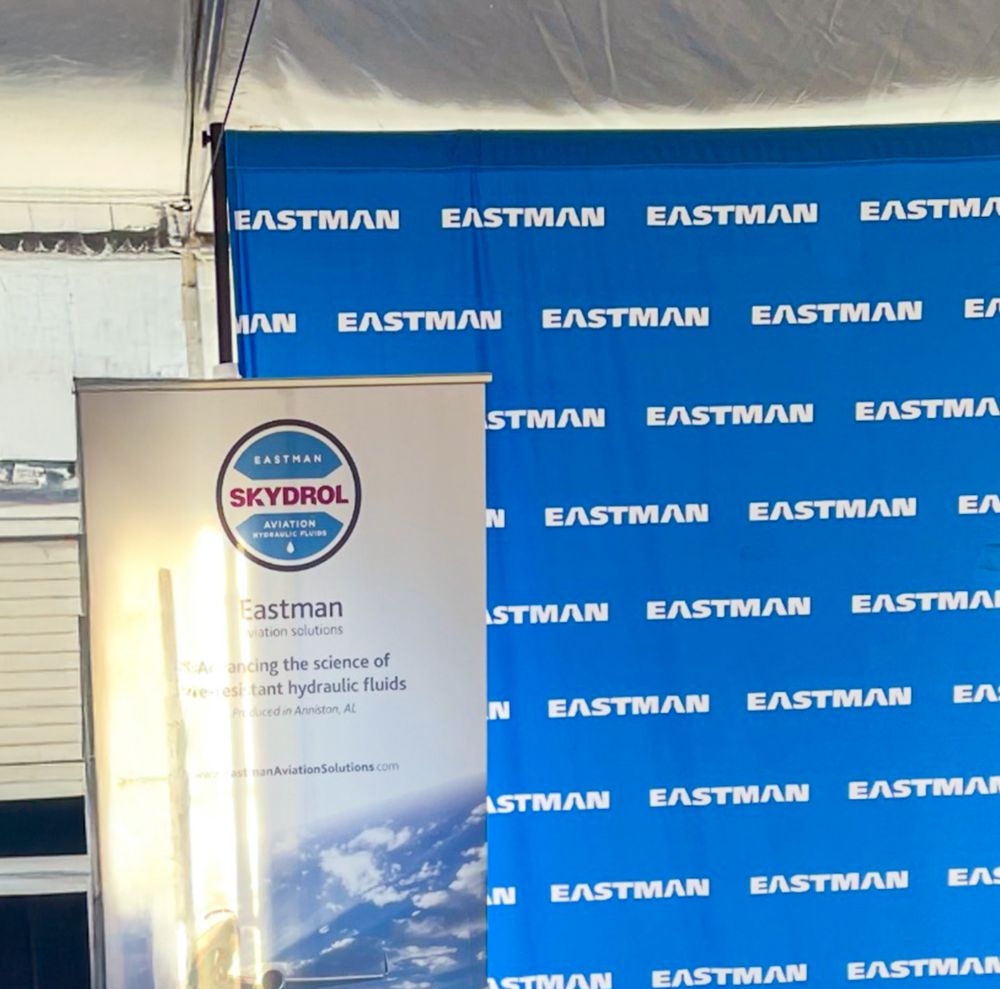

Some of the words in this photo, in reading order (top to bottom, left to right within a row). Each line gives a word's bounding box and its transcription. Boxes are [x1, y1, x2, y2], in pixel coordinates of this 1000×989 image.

[234, 209, 400, 231] EASTMAN
[441, 207, 605, 229] EASTMAN
[647, 203, 818, 227] EASTMAN
[338, 309, 502, 332] EASTMAN
[542, 307, 709, 329] EASTMAN
[751, 300, 922, 325] EASTMAN
[488, 408, 605, 431] STMAN
[646, 403, 814, 427] EASTMAN
[254, 454, 322, 465] EASTMAN
[229, 484, 349, 508] SKYDROL
[263, 519, 316, 529] AVIATION
[545, 503, 709, 527] EASTMAN
[749, 497, 917, 521] EASTMAN
[488, 602, 609, 625] STMAN
[647, 597, 811, 621] EASTMAN
[243, 626, 288, 639] viation
[291, 624, 344, 637] solutions
[198, 658, 279, 676] Aancing
[283, 656, 309, 672] the
[313, 654, 369, 670] science
[373, 652, 391, 668] of
[288, 677, 359, 699] hydraulic
[363, 675, 407, 692] fluids
[232, 704, 280, 718] Prduced
[282, 704, 292, 716] in
[343, 702, 357, 714] AL
[548, 694, 710, 718] EASTMAN
[747, 687, 912, 712] EASTMAN
[487, 791, 610, 814] STMAN
[649, 783, 809, 807] EASTMAN
[550, 878, 710, 902] EASTMAN
[750, 870, 909, 895] EASTMAN
[652, 963, 809, 988] EASTMAN
